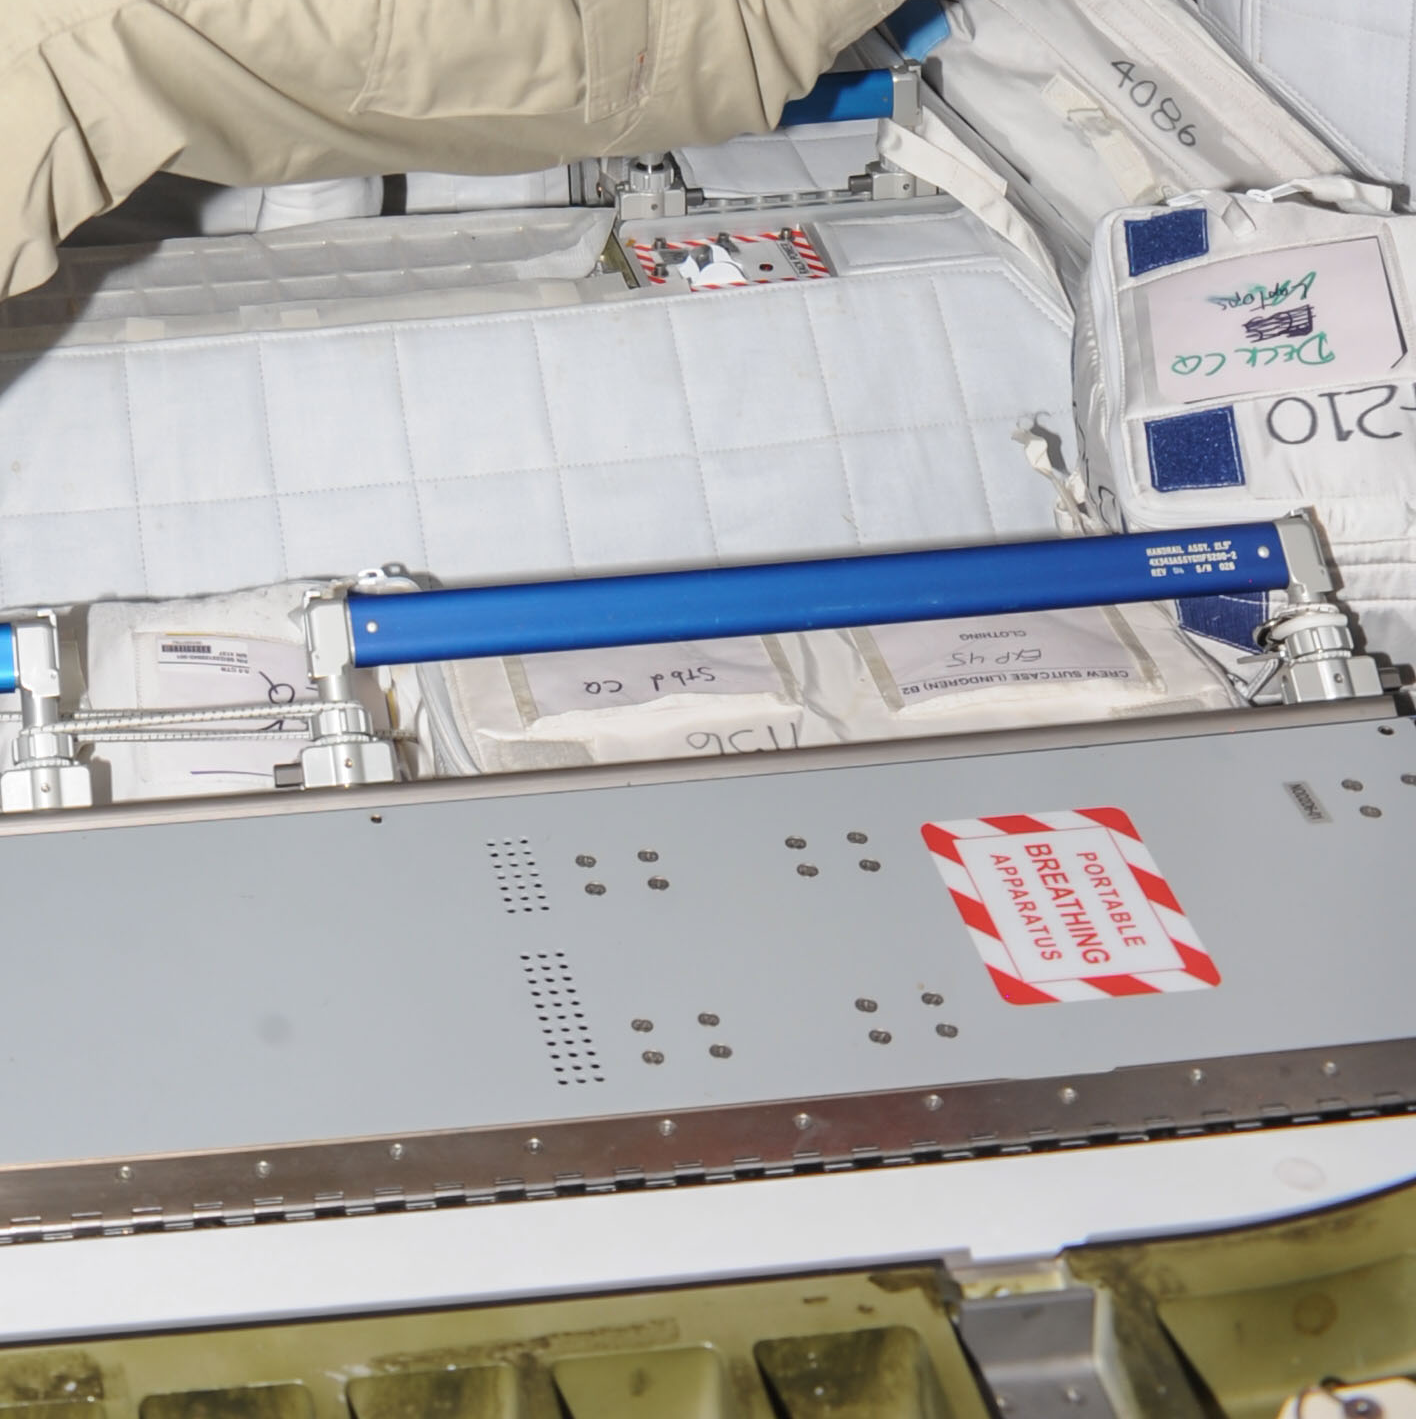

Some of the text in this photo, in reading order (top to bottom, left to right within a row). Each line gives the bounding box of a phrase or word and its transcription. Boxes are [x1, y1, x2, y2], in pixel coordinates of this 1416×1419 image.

[1110, 60, 1197, 148] 4086
[1267, 382, 1416, 445] 210
[959, 630, 1027, 641] CLOTHING
[584, 679, 624, 695] CQ
[923, 672, 1008, 692] (LINDGREN)
[1014, 669, 1083, 681] SUITCASE
[1086, 669, 1129, 679] CREW
[989, 854, 1063, 961] APPARATUS
[1024, 843, 1111, 964] BREATHING
[1076, 851, 1147, 947] PORTABLE
